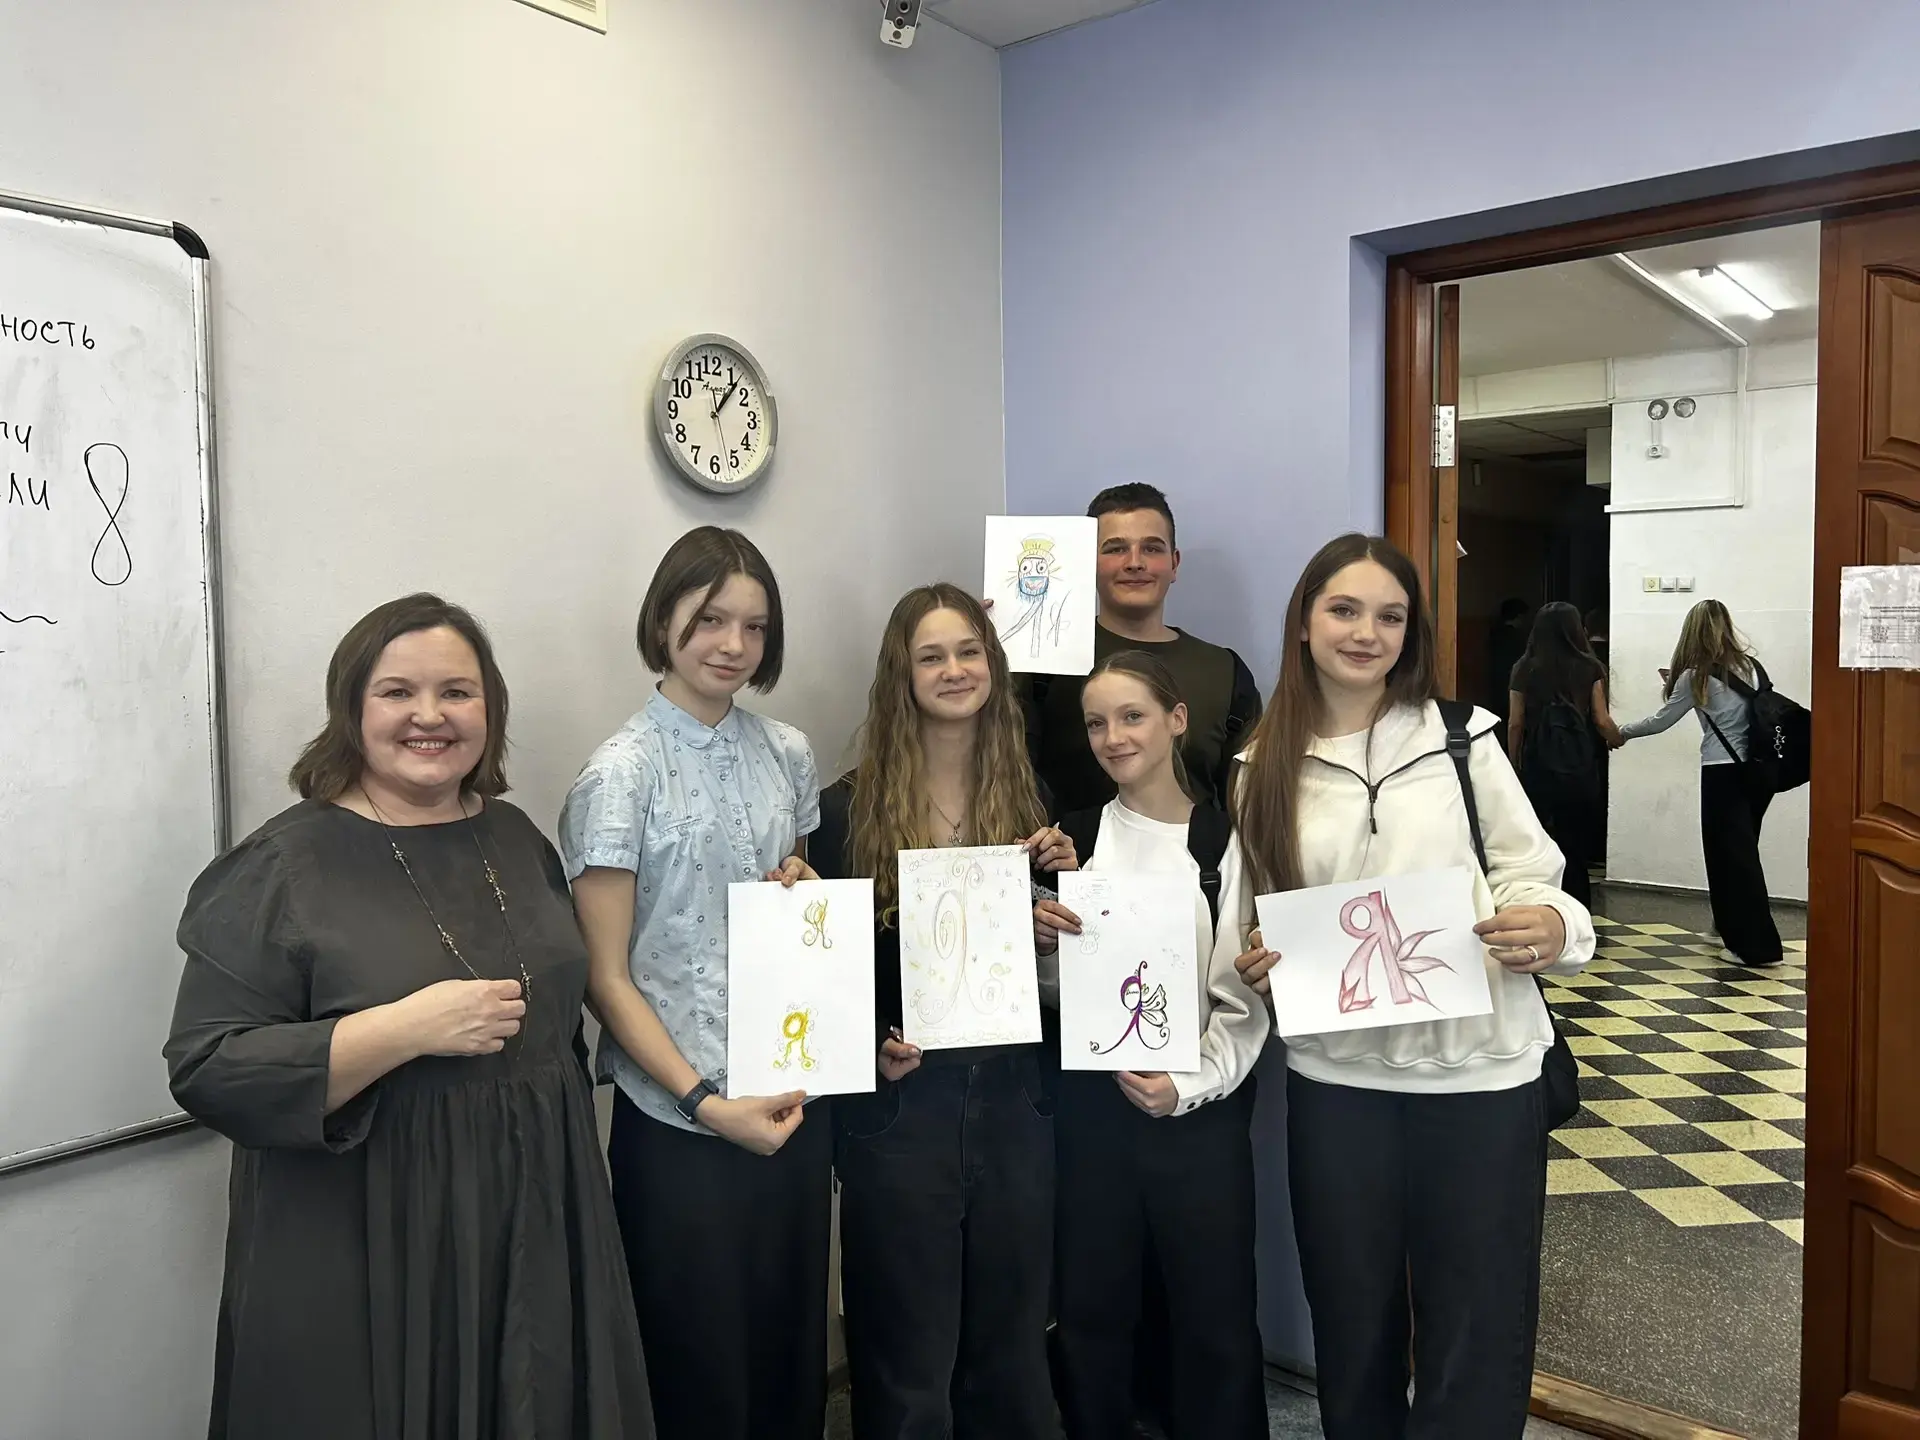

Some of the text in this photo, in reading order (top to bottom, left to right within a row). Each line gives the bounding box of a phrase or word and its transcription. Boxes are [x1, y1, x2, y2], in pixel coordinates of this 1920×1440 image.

[685, 360, 704, 381] 11
[702, 355, 722, 376] 12
[727, 367, 734, 386] 1
[672, 378, 692, 399] 10
[739, 388, 749, 407] 2
[667, 400, 679, 419] 9
[747, 411, 757, 430] 3
[675, 423, 687, 443] 8
[741, 432, 751, 450] 4
[690, 445, 701, 465] 7
[709, 455, 720, 474] 6
[729, 449, 739, 468] 5
